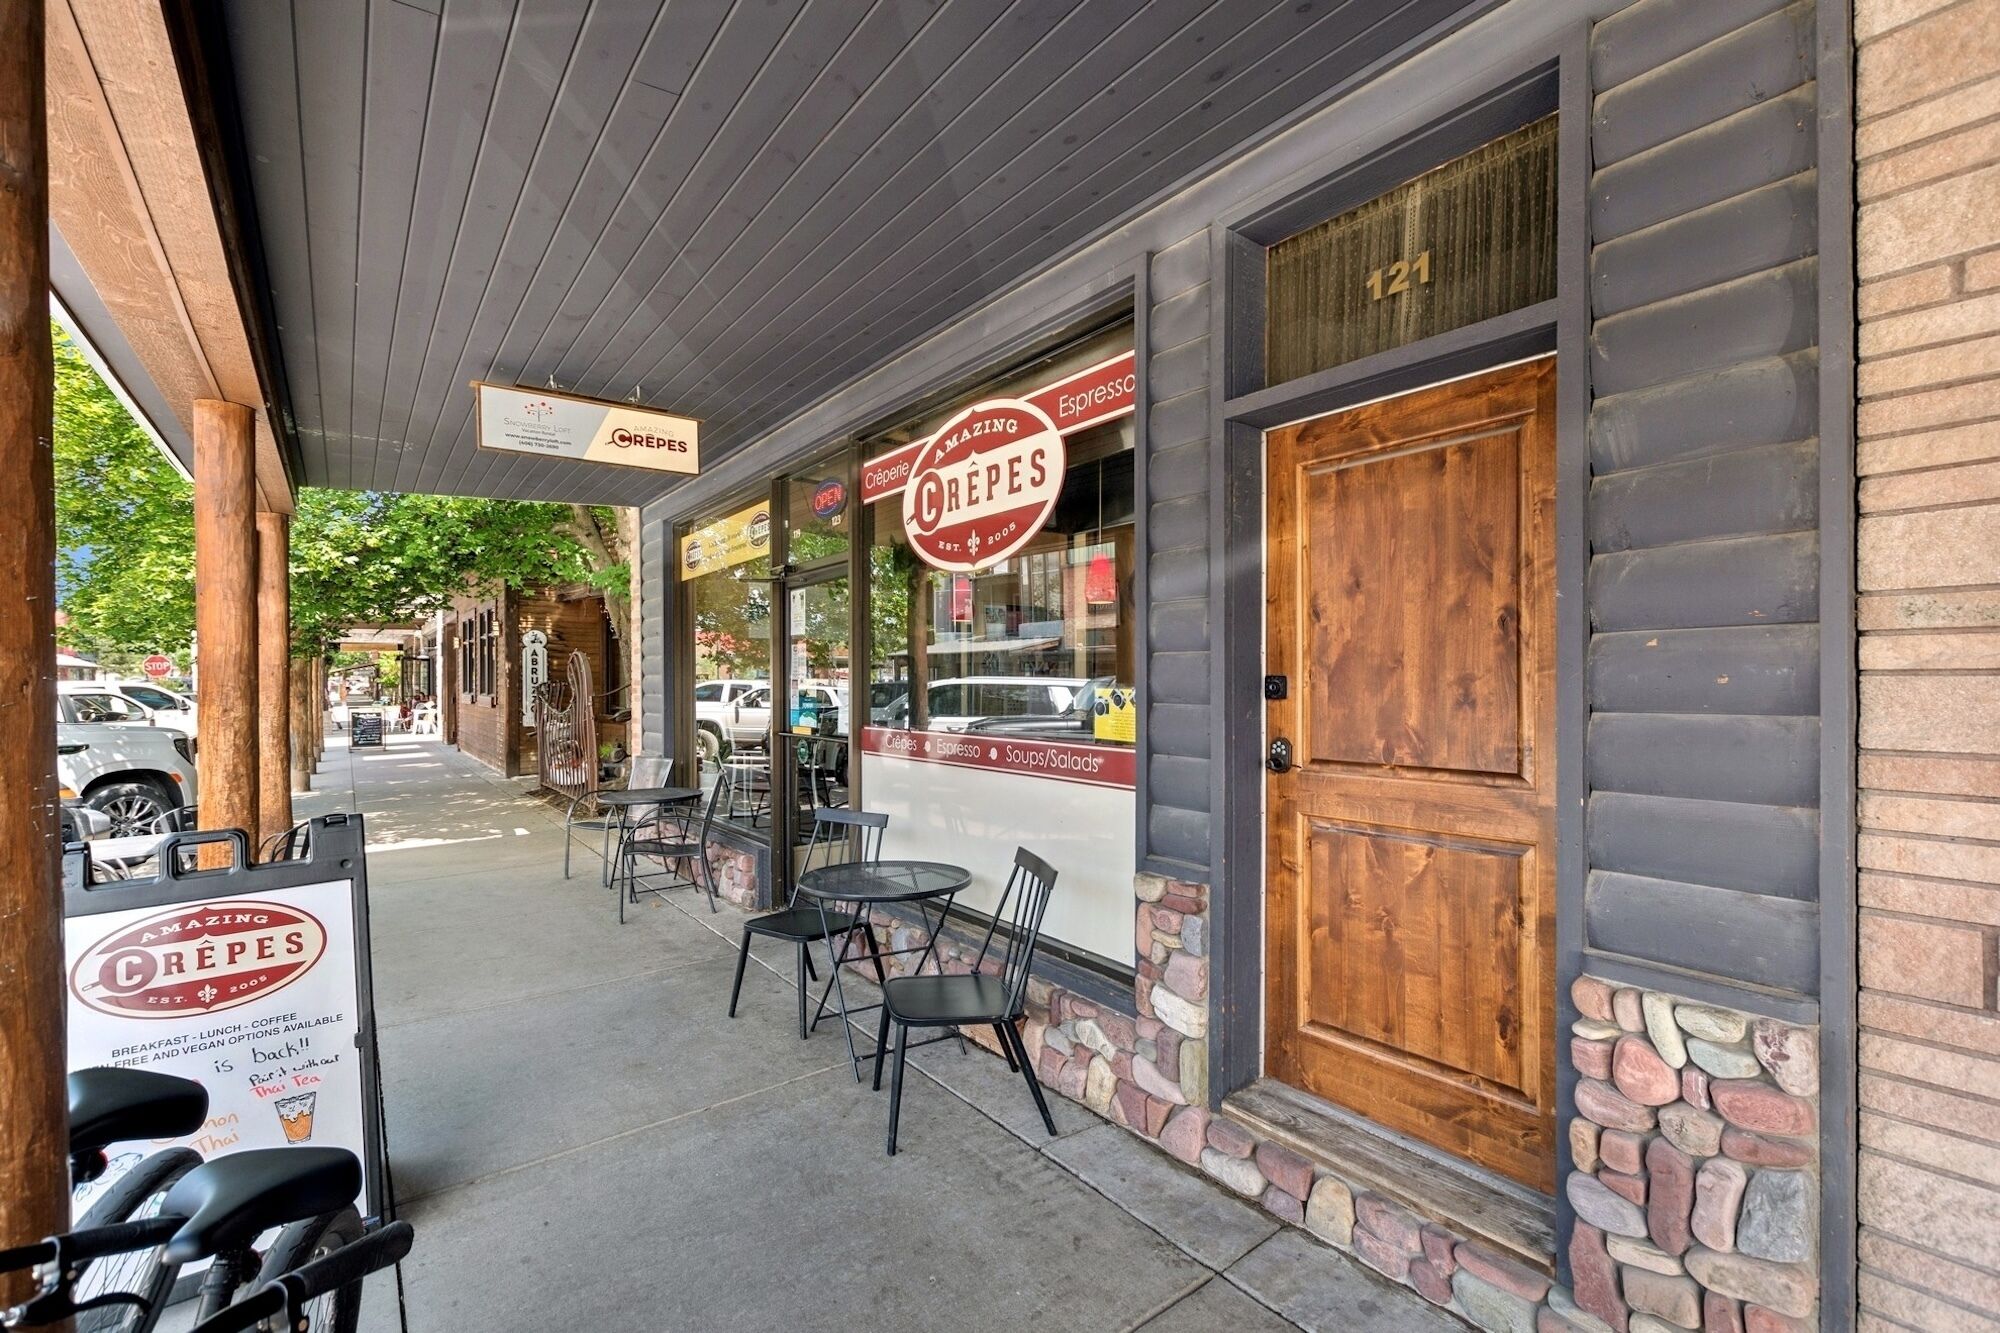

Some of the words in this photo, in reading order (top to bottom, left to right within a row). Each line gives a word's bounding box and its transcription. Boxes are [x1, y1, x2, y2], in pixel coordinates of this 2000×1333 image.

[1366, 250, 1430, 301] 121
[1059, 374, 1135, 418] Espresso
[633, 425, 674, 437] AMAZING
[933, 418, 1018, 464] AMAZING
[865, 460, 910, 490] Crêperie
[921, 447, 1046, 523] CRÊPES
[814, 487, 842, 510] OPEN
[938, 540, 962, 552] EST.
[987, 521, 1017, 545] 2005
[145, 661, 170, 671] STOP
[885, 735, 917, 751] Crêpes
[936, 739, 981, 758] Espresso
[1005, 745, 1099, 773] Soups/Salads
[139, 913, 270, 944] AMAZING
[114, 932, 305, 987] CRÊPES
[146, 995, 188, 1004] EST.
[228, 975, 268, 994] 2005
[111, 1034, 190, 1058] BREAKFAST
[199, 1024, 242, 1040] LUNCH
[251, 1012, 298, 1029] COFFEE
[152, 1048, 180, 1062] AND
[182, 1038, 225, 1054] VEGAN
[228, 1027, 281, 1046] OPTIONS
[283, 1013, 344, 1033] AVAILABLE
[214, 1060, 234, 1073] is
[249, 1080, 286, 1097] Thai
[291, 1074, 322, 1087] Tea
[188, 1129, 241, 1153] Thai
